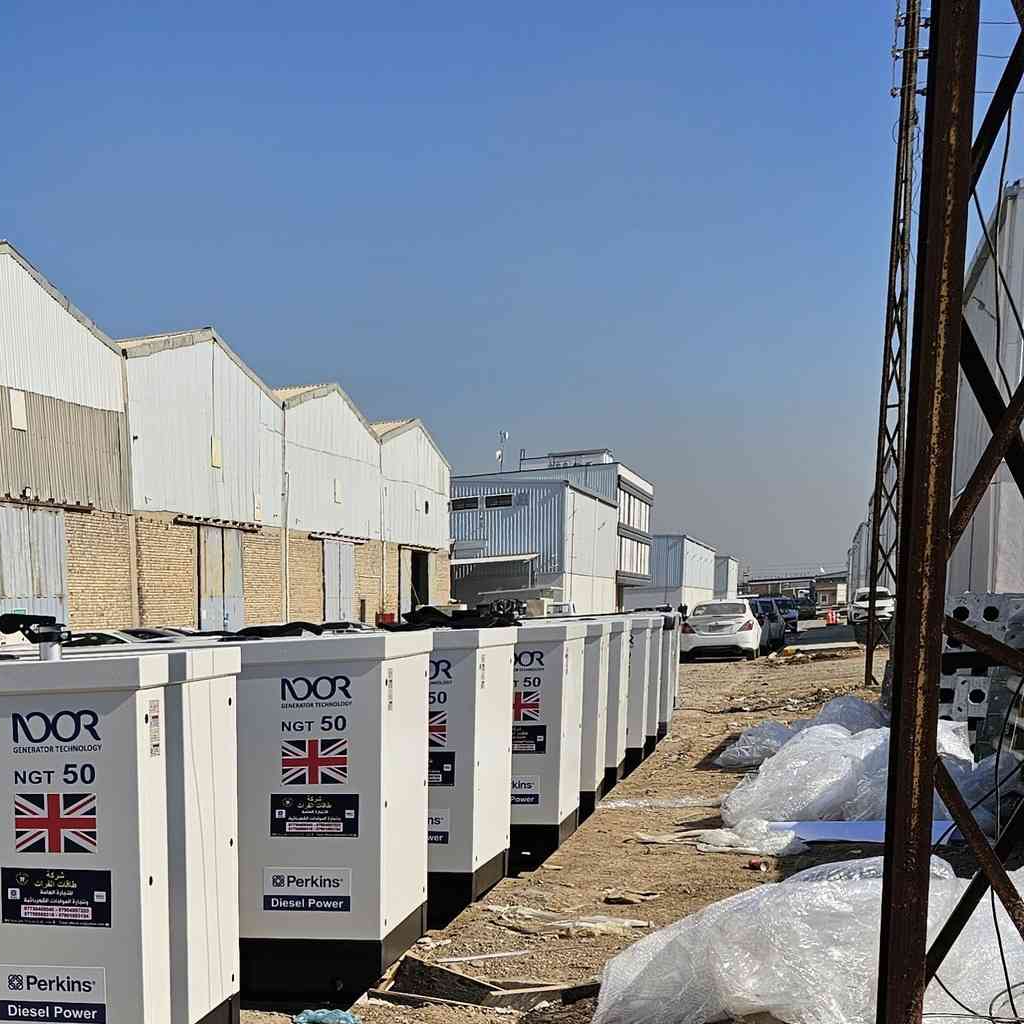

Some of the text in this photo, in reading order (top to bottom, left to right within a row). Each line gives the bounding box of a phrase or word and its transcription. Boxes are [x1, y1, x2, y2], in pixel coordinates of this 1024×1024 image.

[280, 675, 352, 701] NOOR
[523, 677, 541, 687] 50
[429, 691, 447, 704] 50
[11, 710, 101, 744] NOOR
[281, 715, 347, 732] NGT 50
[13, 744, 102, 754] GENERATOR TECHNOLOGY
[14, 763, 96, 785] NGT 50
[271, 898, 344, 908] Diesel Power
[7, 1004, 97, 1019] Diesel Power
